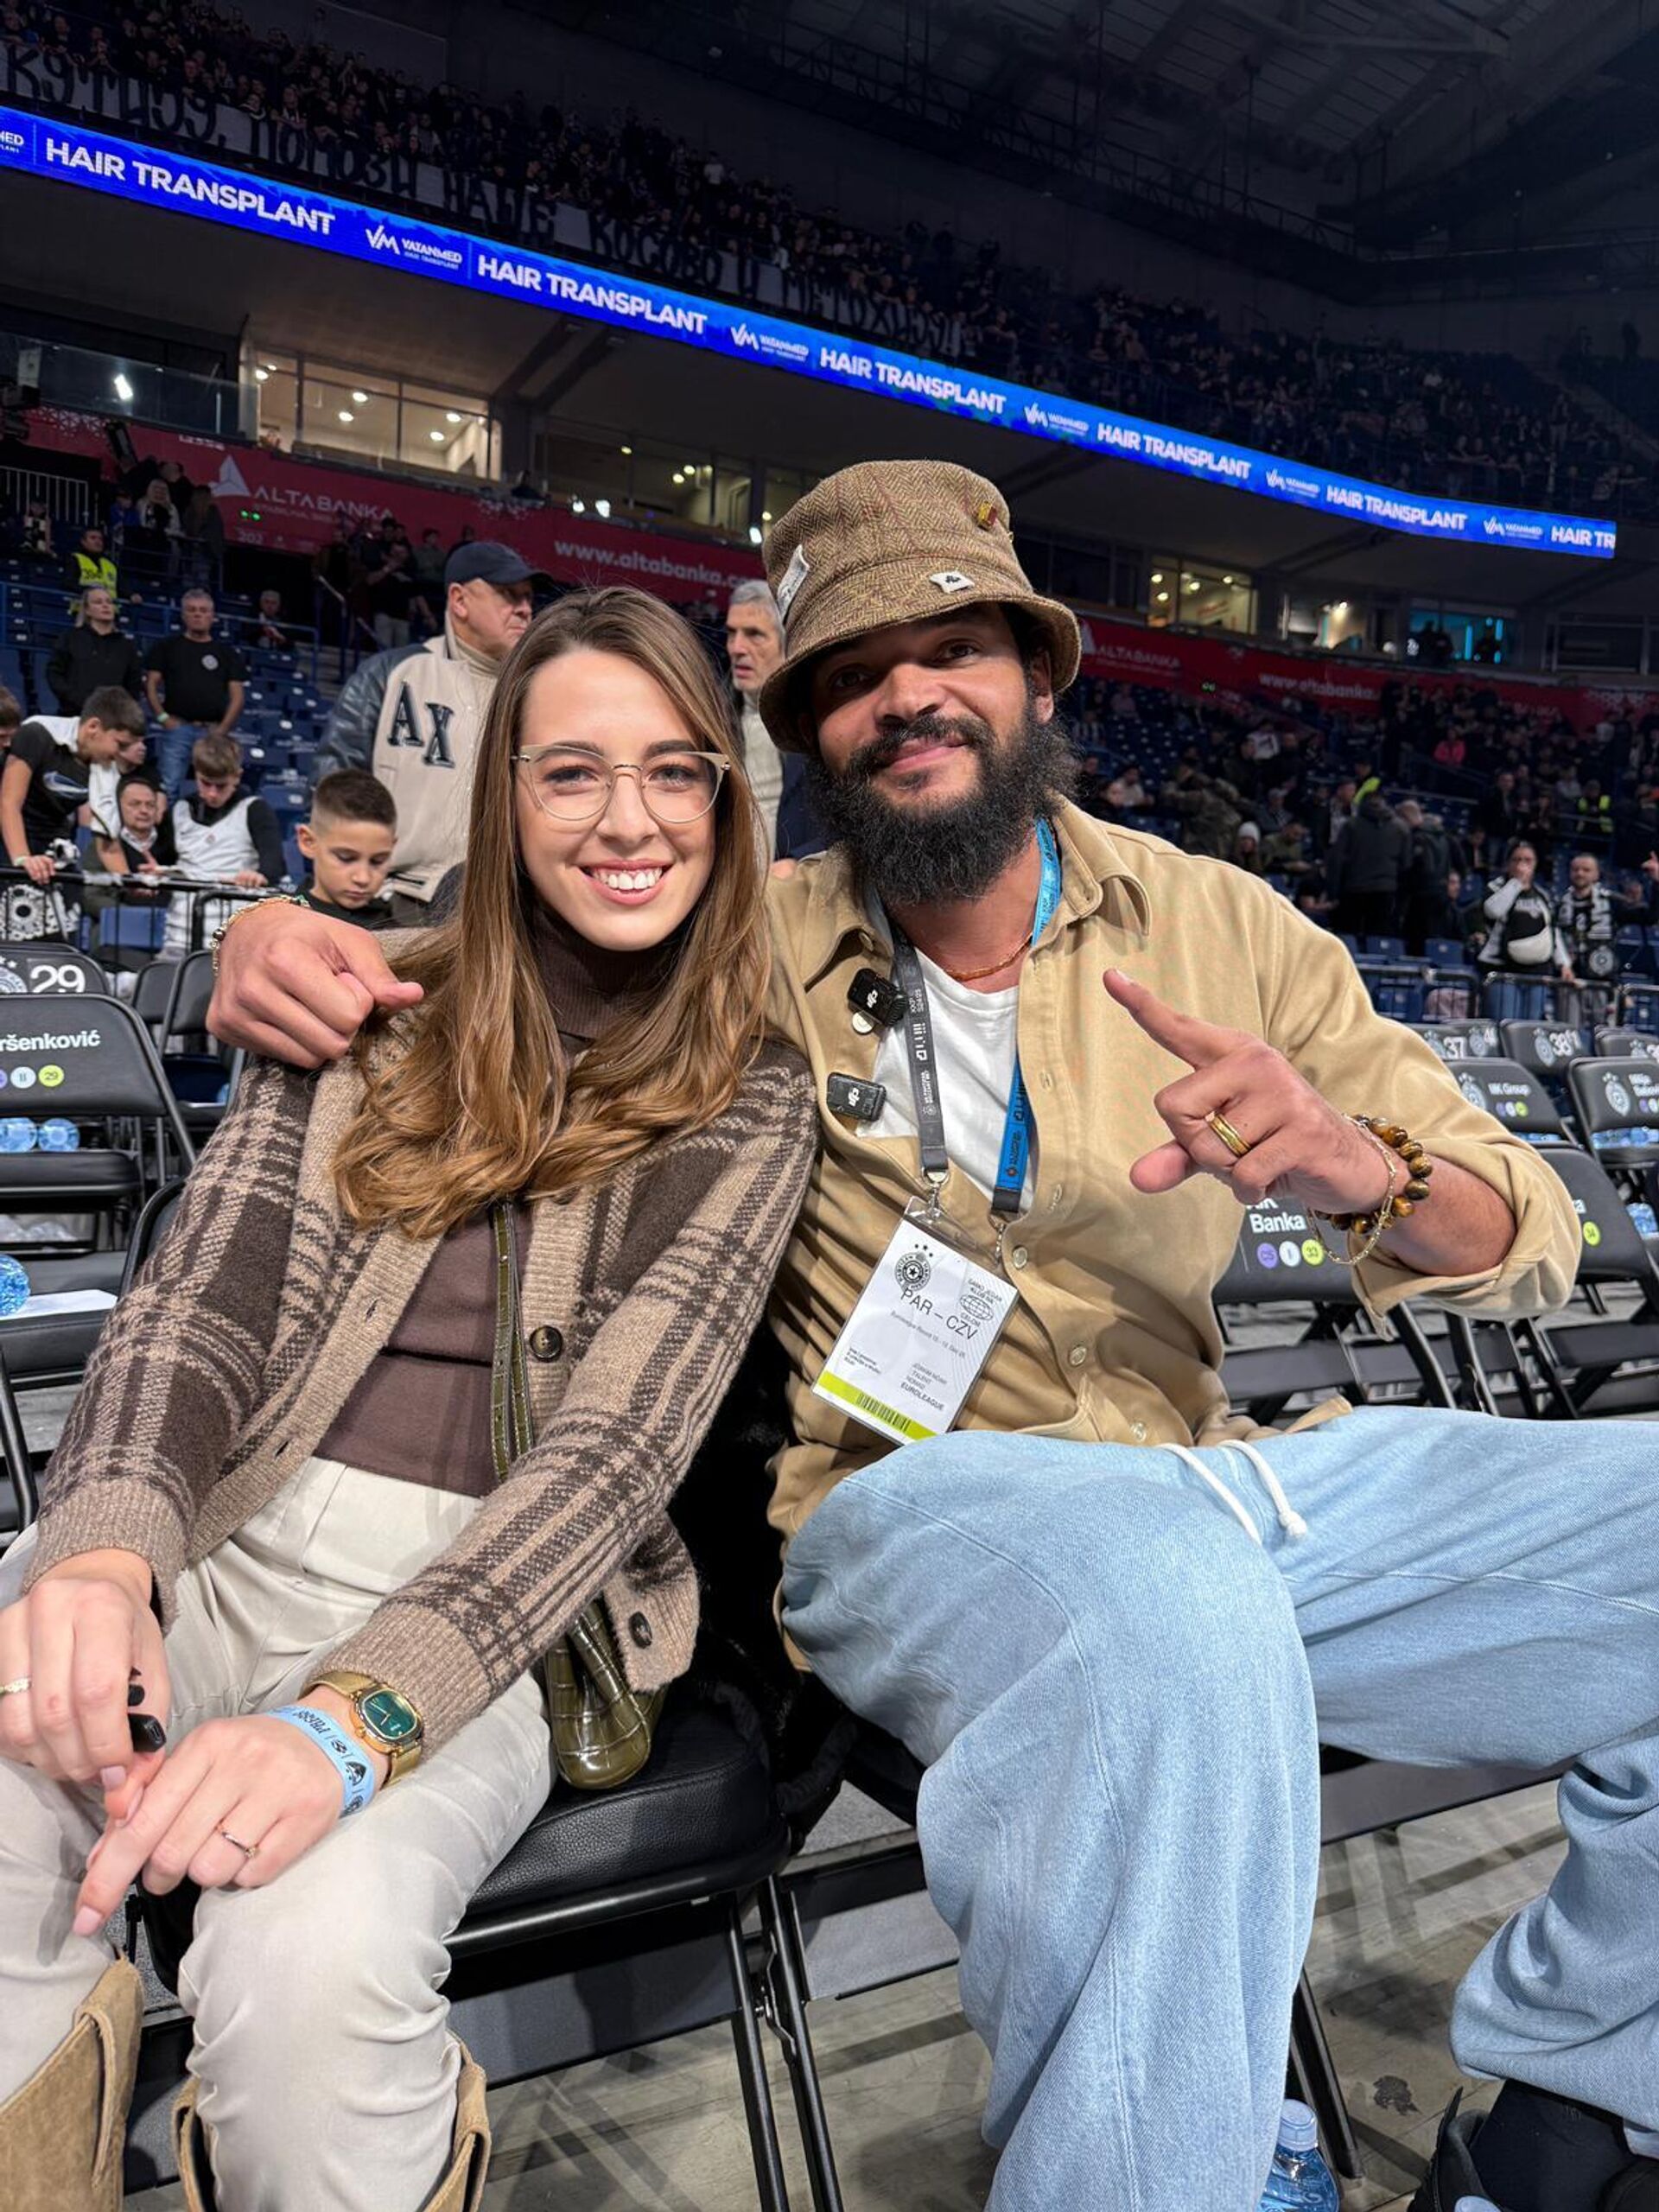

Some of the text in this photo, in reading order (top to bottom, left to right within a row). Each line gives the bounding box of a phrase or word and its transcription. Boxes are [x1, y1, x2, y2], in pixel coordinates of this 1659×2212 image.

[47, 137, 335, 235] HAIR TRANSPLANT
[478, 254, 708, 334] HAIR TRANSPLANT
[820, 347, 1006, 414] HAIR TRANSPLANT
[1097, 423, 1251, 480] HAIR TRANSPLANT
[253, 486, 394, 519] ALTABANKA
[1326, 486, 1467, 531] HAIR TRANSPLANT
[1551, 525, 1592, 546] HAIR
[30, 964, 86, 993] 29
[1249, 1211, 1307, 1233] Banka
[899, 1287, 935, 1315] PAR
[943, 1313, 979, 1341] CZV
[899, 1380, 945, 1412] EUROLEAGUE
